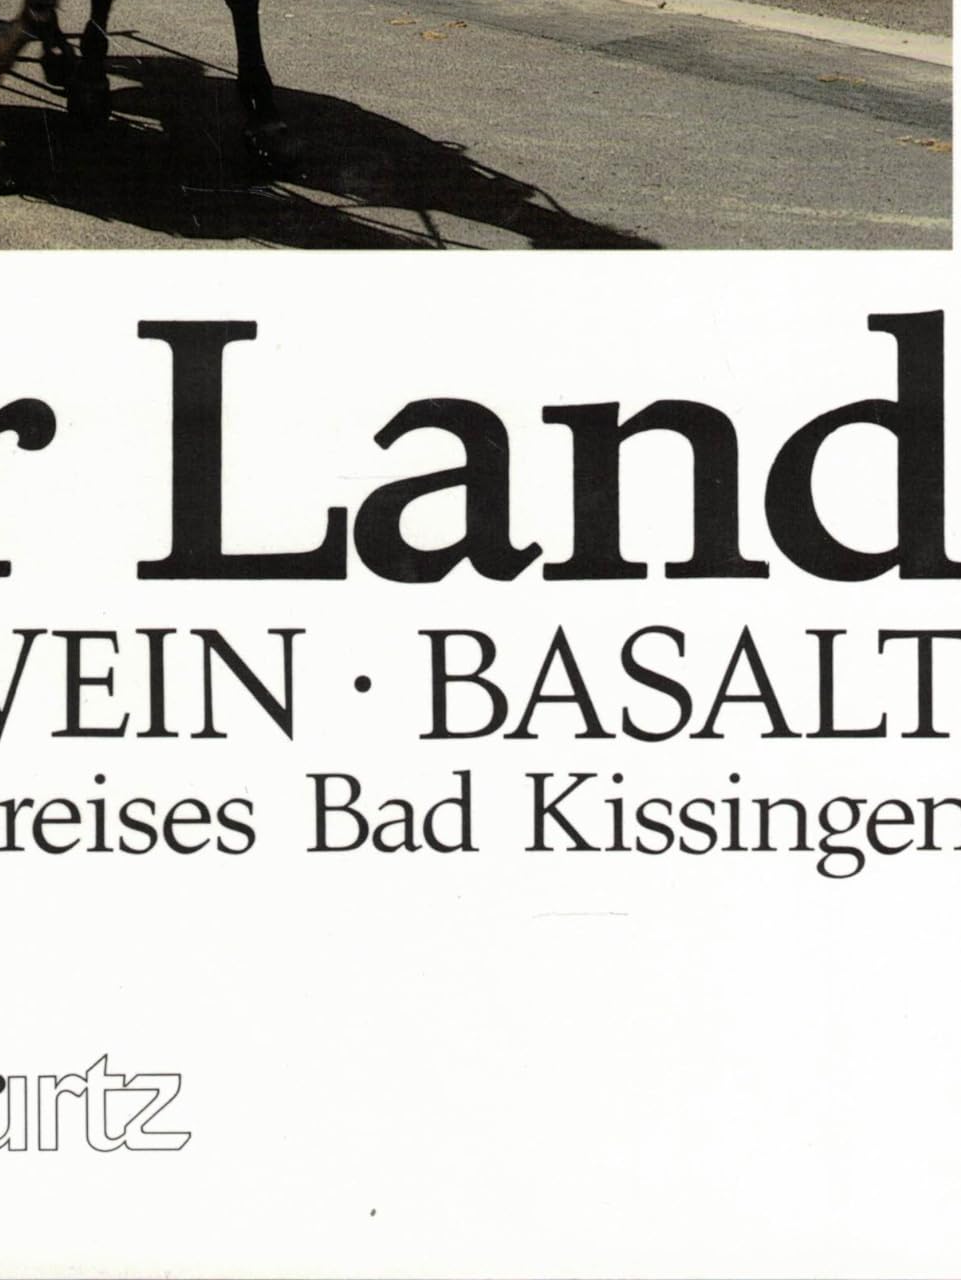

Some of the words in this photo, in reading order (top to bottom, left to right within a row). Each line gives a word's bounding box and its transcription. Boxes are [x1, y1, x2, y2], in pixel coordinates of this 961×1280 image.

[137, 309, 961, 584] Land
[417, 625, 961, 743] BASALT
[305, 769, 480, 855] Bad
[524, 772, 961, 879] Kissingen
